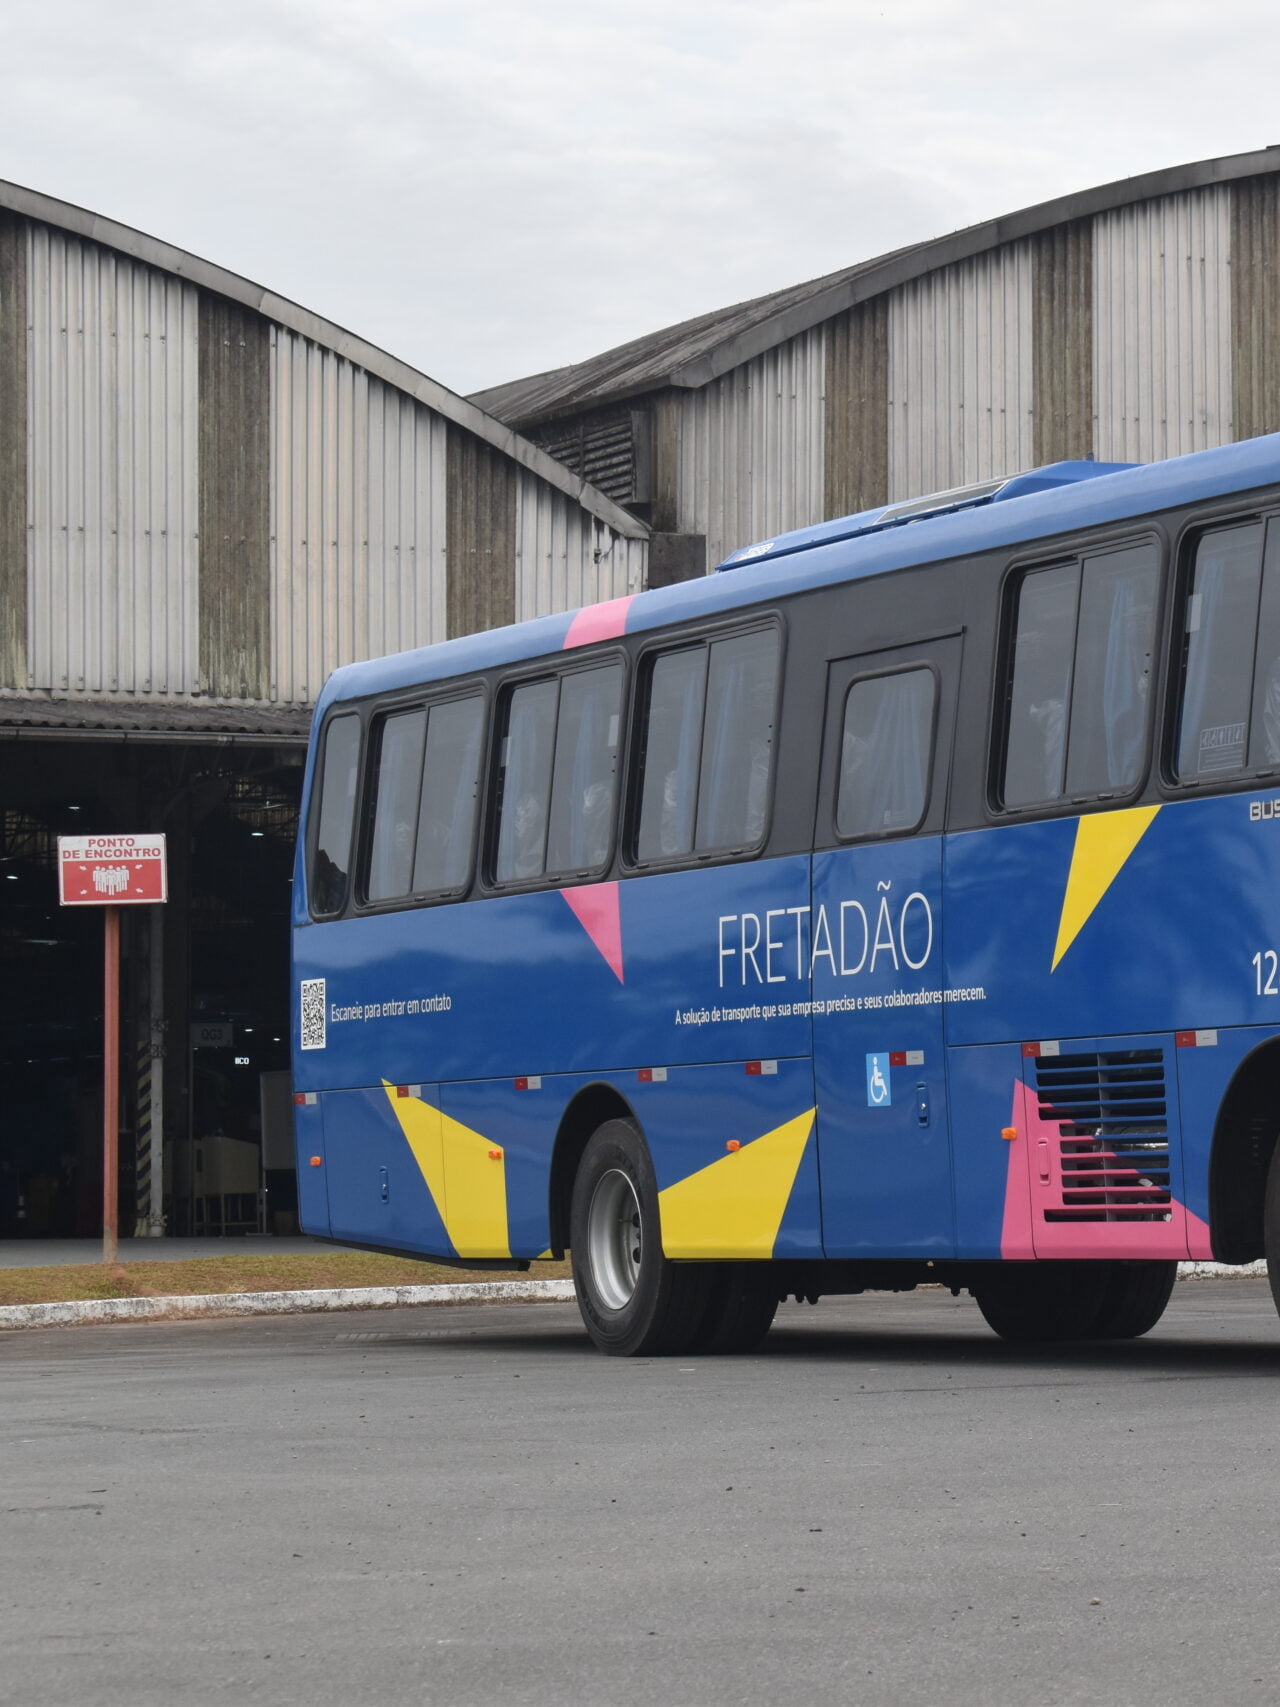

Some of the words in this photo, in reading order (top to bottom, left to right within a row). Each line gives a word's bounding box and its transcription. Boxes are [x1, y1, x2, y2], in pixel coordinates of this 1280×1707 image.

[63, 850, 80, 859] DE
[85, 848, 161, 858] ENCONTRO
[88, 838, 135, 847] PONTO
[719, 879, 932, 988] FRETADÃO
[331, 1001, 363, 1022] Escaneie
[364, 1003, 381, 1022] para
[382, 999, 405, 1017] entrar
[407, 999, 420, 1014] em
[421, 993, 452, 1013] contato
[675, 1010, 682, 1025] A
[682, 1007, 710, 1026] solução
[711, 1005, 721, 1022] de
[722, 1003, 761, 1022] transporte
[762, 1004, 777, 1020] que
[778, 1003, 791, 1016] sua
[792, 1000, 825, 1017] empresa
[826, 994, 855, 1015] precisa
[857, 997, 863, 1009] e
[864, 995, 883, 1009] seus
[884, 987, 942, 1007] colaboradores
[943, 986, 987, 1002] merecem.
